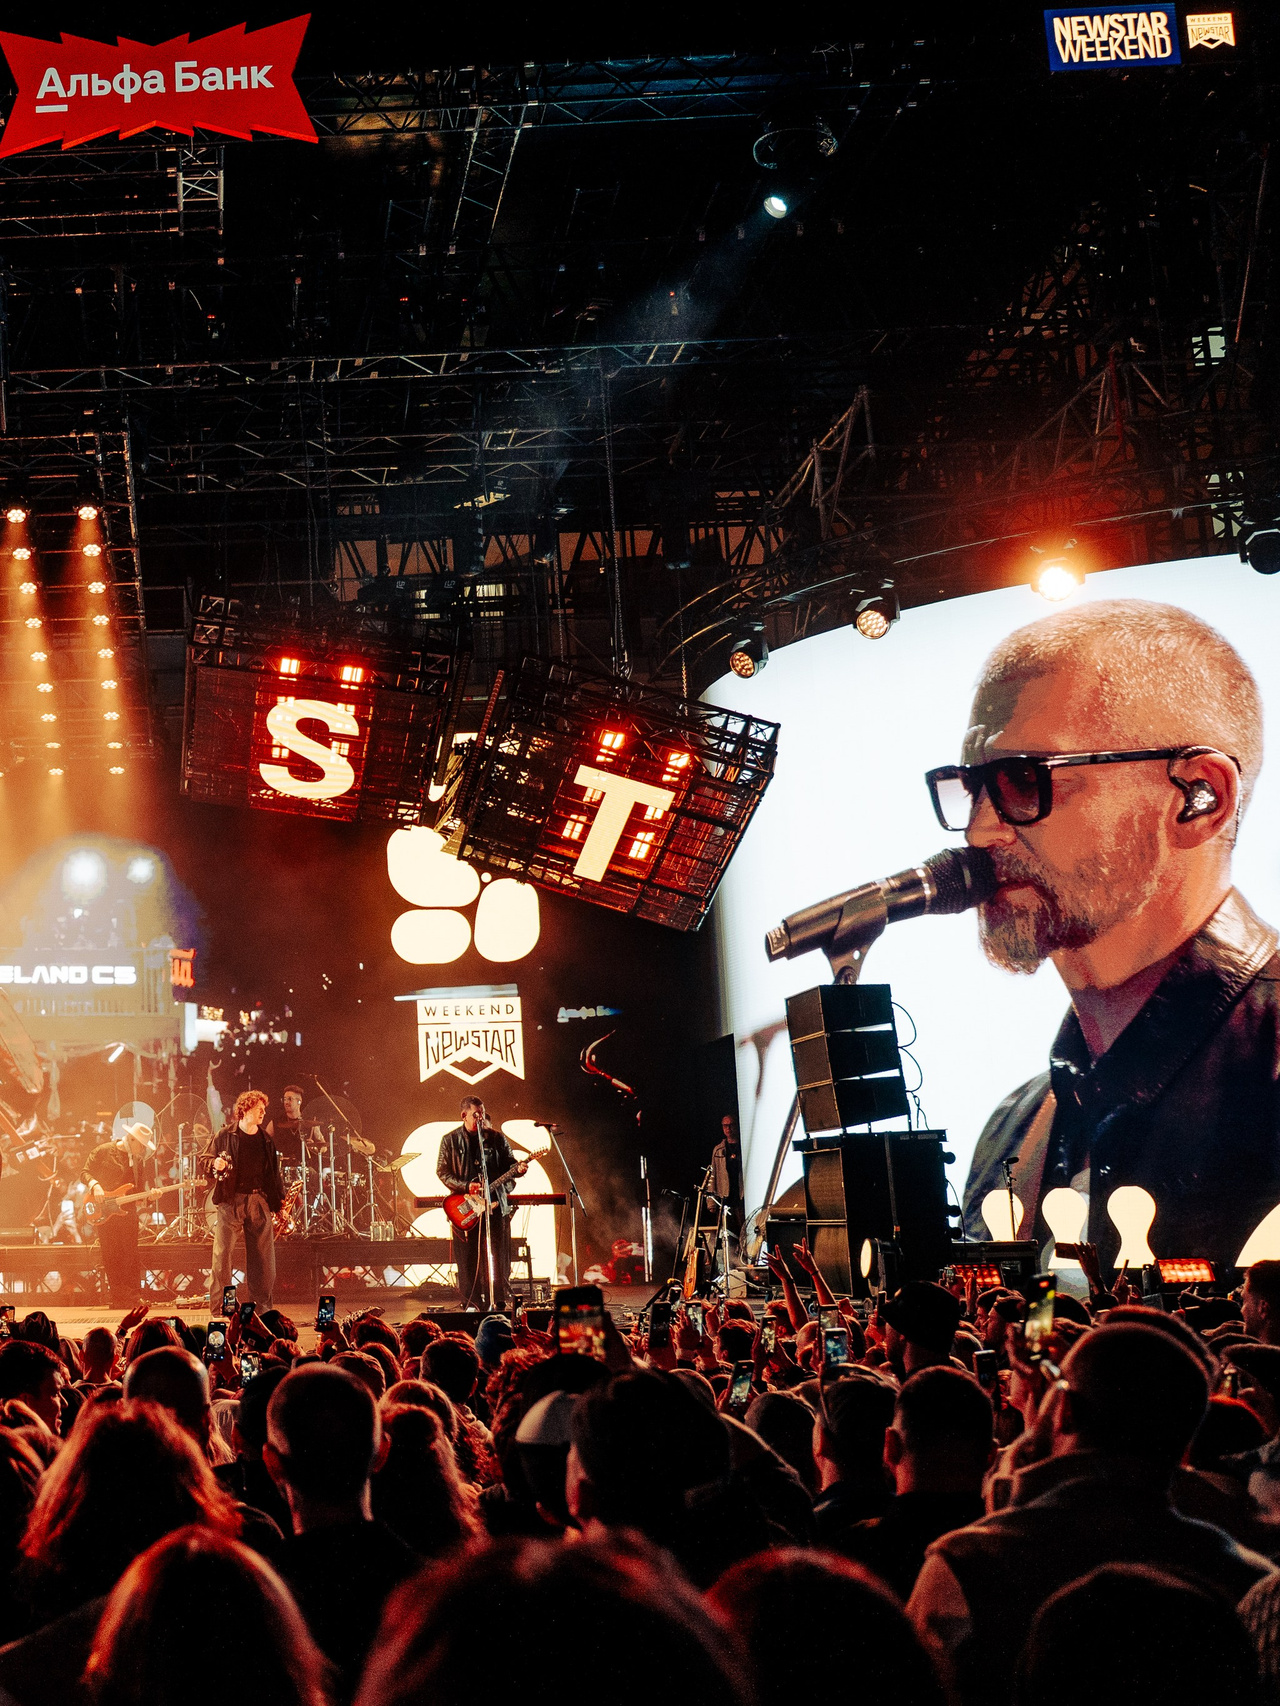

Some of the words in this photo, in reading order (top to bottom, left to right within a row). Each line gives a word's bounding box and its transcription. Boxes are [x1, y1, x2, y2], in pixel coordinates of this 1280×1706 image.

[1053, 11, 1170, 42] NEWSTAR
[1055, 35, 1173, 63] WEEKEND
[35, 63, 166, 106] Альфа
[174, 60, 275, 93] Банк
[259, 698, 360, 800] S
[573, 764, 676, 882] T
[424, 1003, 515, 1017] WEEKEND
